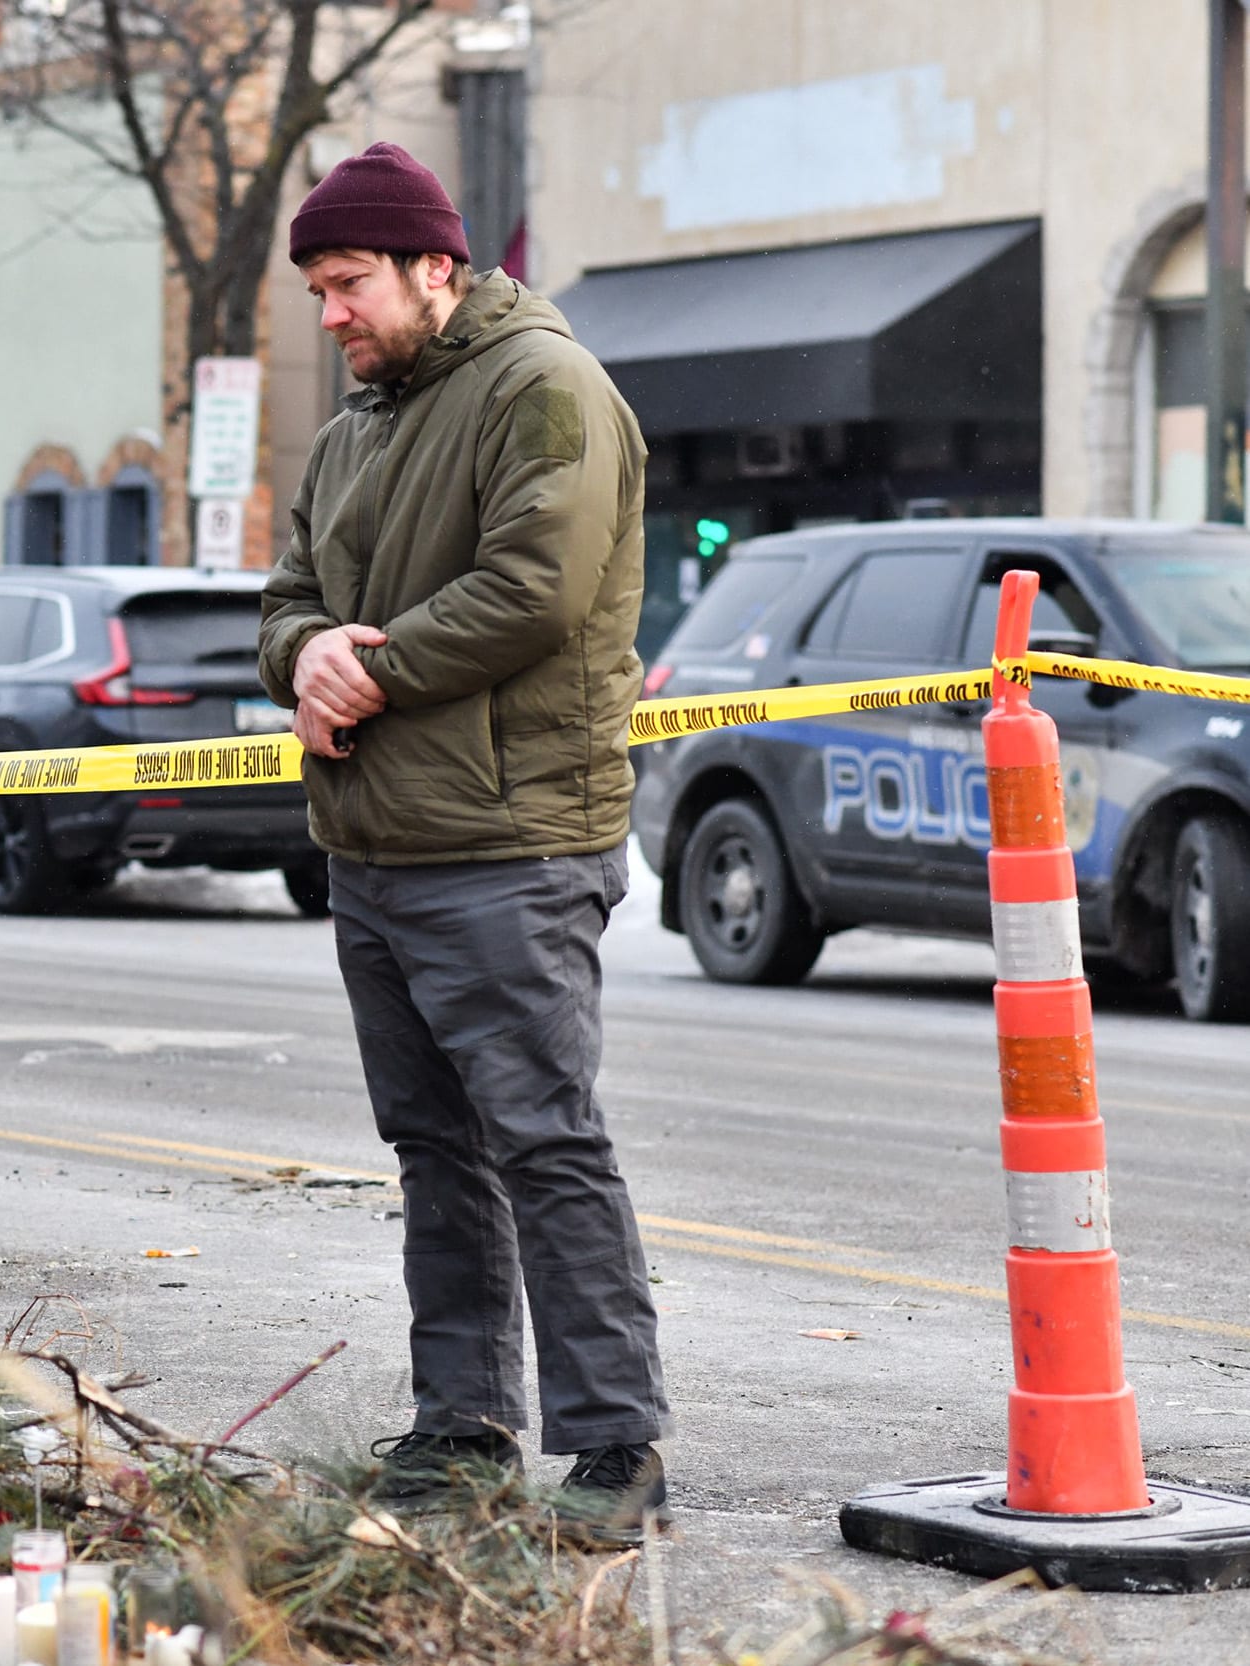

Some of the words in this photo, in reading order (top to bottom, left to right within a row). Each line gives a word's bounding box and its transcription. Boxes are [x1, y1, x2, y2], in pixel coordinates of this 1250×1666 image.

[660, 709, 683, 734] DO
[683, 706, 718, 731] LINE
[719, 701, 770, 726] POLICE
[3, 760, 22, 789] DO
[18, 759, 46, 789] LINE
[43, 757, 81, 788] POLICE
[134, 751, 171, 784] CROSS
[171, 750, 196, 782] NOT
[198, 748, 213, 782] DO
[215, 747, 240, 780] LINE
[243, 743, 281, 779] POLICE
[823, 744, 992, 847] POLIC
